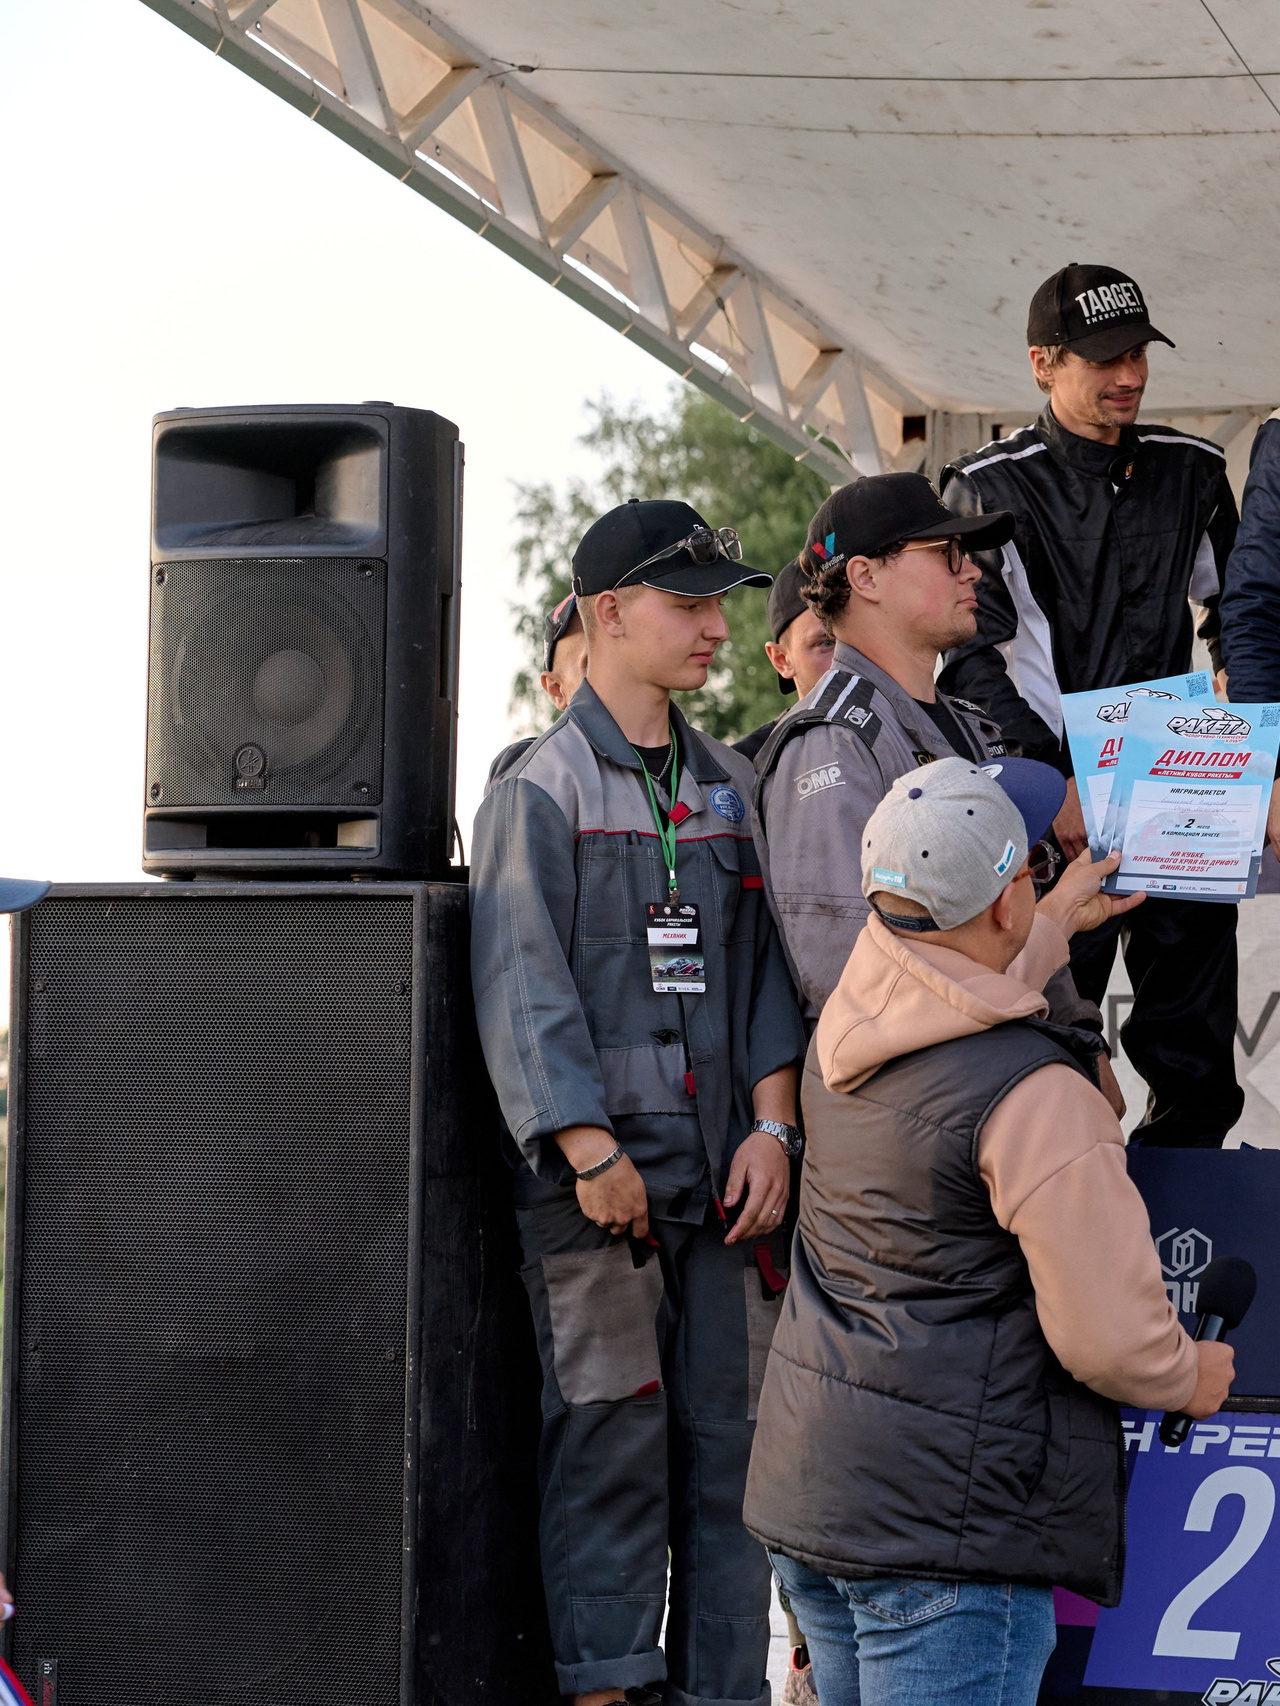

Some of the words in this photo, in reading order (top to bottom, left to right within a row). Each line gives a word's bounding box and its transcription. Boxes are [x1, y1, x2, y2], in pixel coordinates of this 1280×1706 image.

[1075, 282, 1141, 318] TARGET
[1085, 310, 1121, 325] ENERGY
[847, 706, 869, 726] OMP
[1166, 716, 1252, 736] РАКЕТА
[1154, 749, 1252, 768] ДИПЛОМ
[796, 765, 843, 796] OMP
[1170, 788, 1226, 796] НАГРАЖДАЕТСЯ
[1184, 818, 1196, 829] 2
[1132, 855, 1177, 864] АЛТАЙСКОГО
[1209, 859, 1240, 867] ДРИФТУ
[1151, 1465, 1277, 1661] 2
